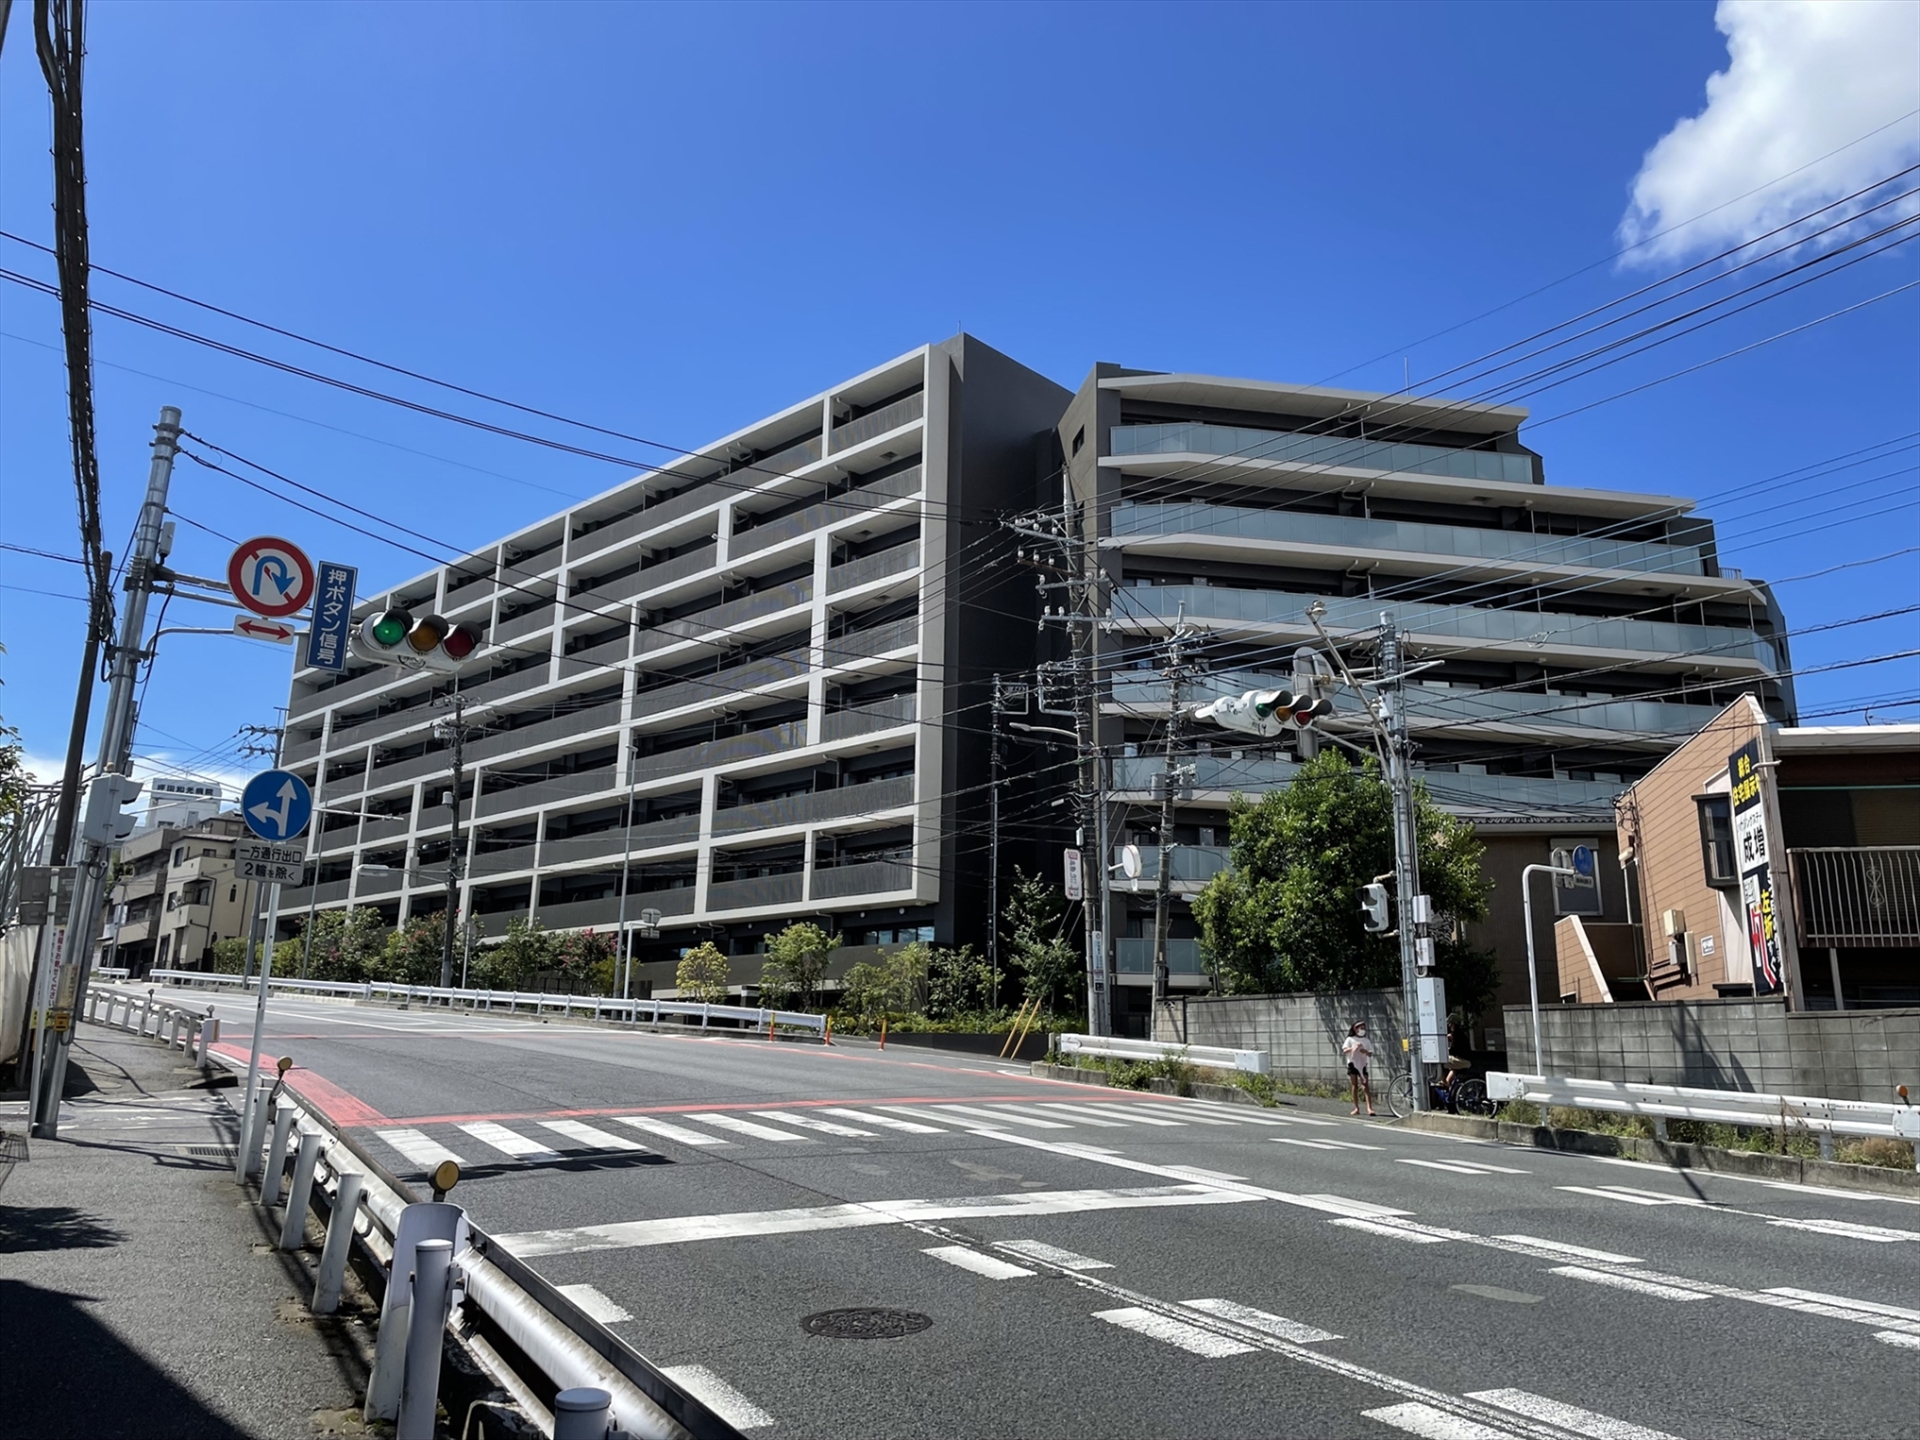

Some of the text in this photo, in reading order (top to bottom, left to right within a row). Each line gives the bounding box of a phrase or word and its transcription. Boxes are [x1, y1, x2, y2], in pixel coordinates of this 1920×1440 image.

[317, 568, 347, 665] 押ボタン信号
[239, 845, 302, 863] 一方通行出口
[1743, 824, 1765, 863] 成増
[244, 862, 295, 881] 2輪を除く
